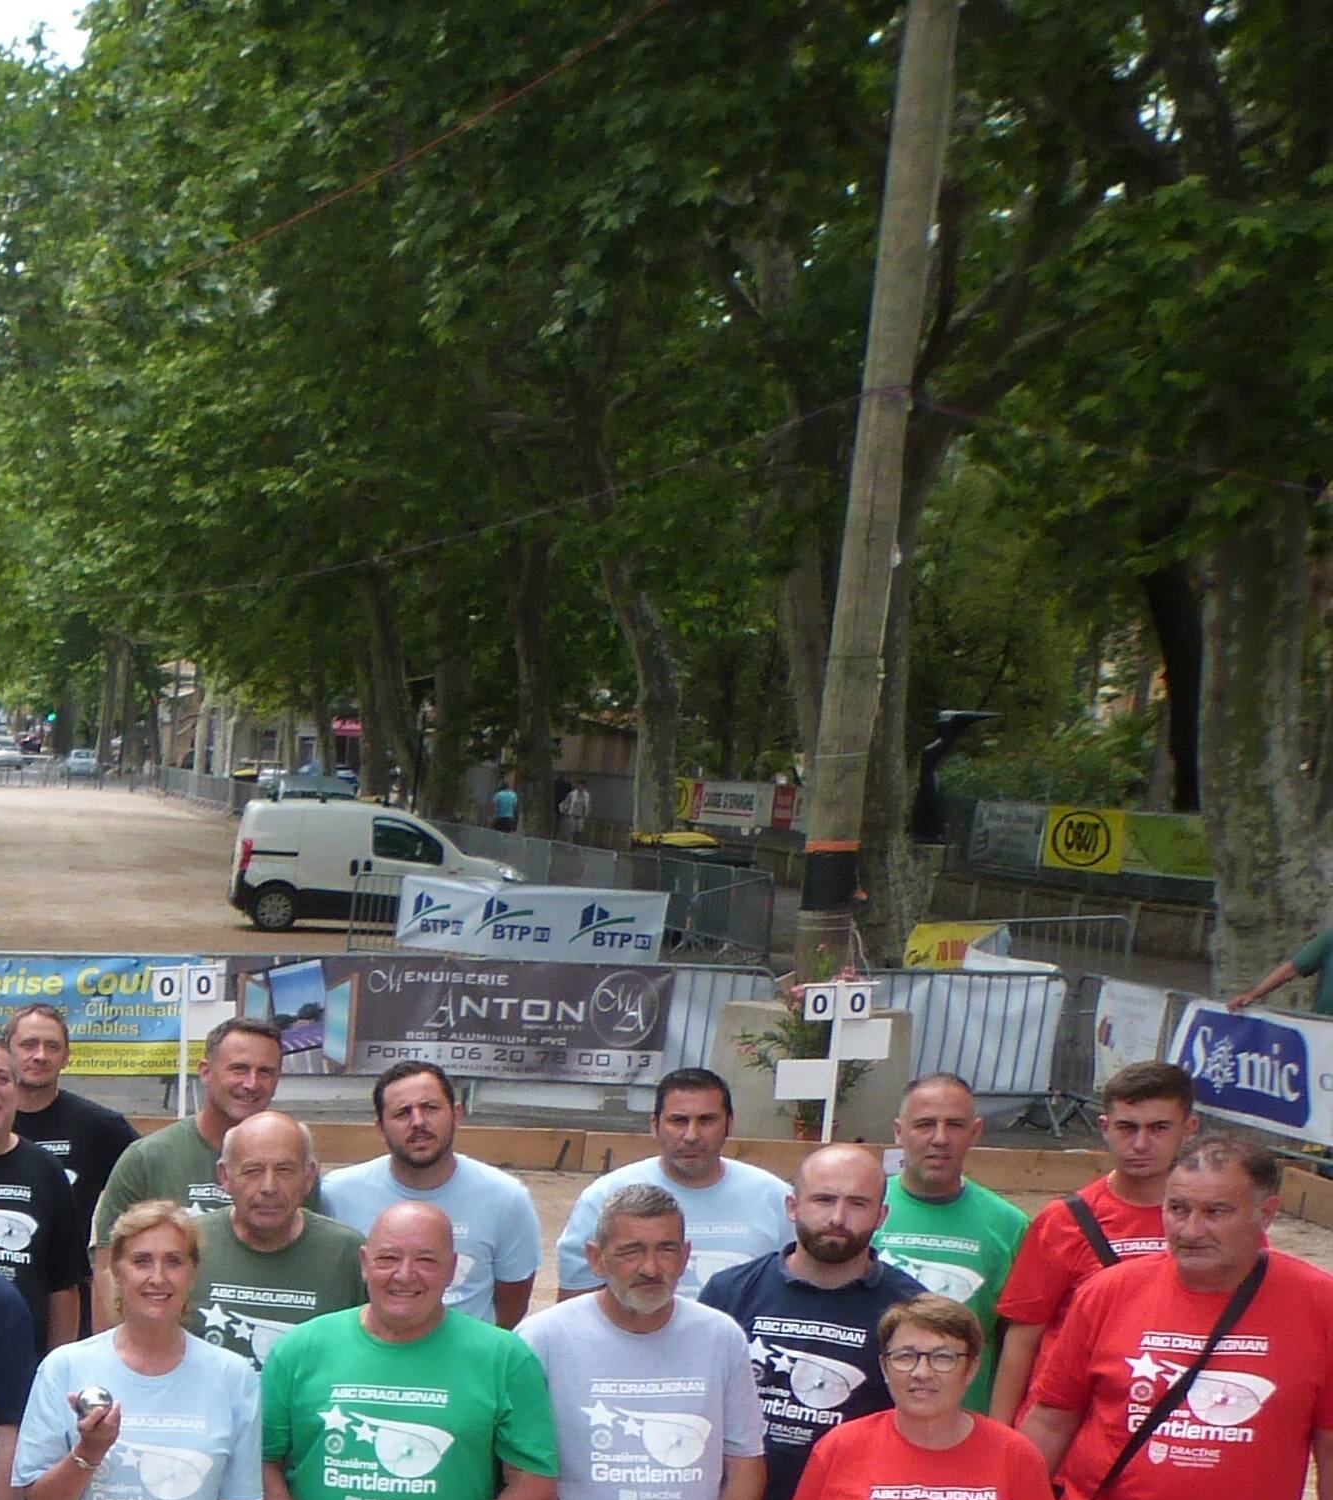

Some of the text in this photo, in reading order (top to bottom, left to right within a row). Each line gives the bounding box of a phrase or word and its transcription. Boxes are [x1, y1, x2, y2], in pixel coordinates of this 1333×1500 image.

[420, 917, 450, 935] BTP
[492, 924, 531, 942] BTP
[592, 931, 632, 949] BTP
[77, 965, 154, 996] Coul
[159, 975, 211, 997] 0 0
[367, 965, 510, 994] MENUISERIE
[424, 987, 584, 1029] ANTON
[813, 993, 865, 1014] 0 0
[405, 1031, 439, 1041] BOIS
[449, 1032, 527, 1044] ALUMINIUM
[451, 1046, 482, 1060] 06
[494, 1048, 526, 1062] 20
[578, 1053, 610, 1067] 00
[625, 1055, 650, 1068] 13
[209, 1287, 317, 1306] ABC DRAGUIGNAN
[753, 1320, 866, 1344] ABC DRAGUIGNAN
[1140, 1335, 1170, 1348] ABC
[330, 1387, 449, 1404] ABC DRAGUIGNAN
[591, 1381, 706, 1394] ABC DRAGUIGNAN
[762, 1398, 843, 1425] ntlemen
[323, 1467, 437, 1494] Gentlemen
[591, 1463, 703, 1483] Gentlemen
[870, 1489, 900, 1500] ABC
